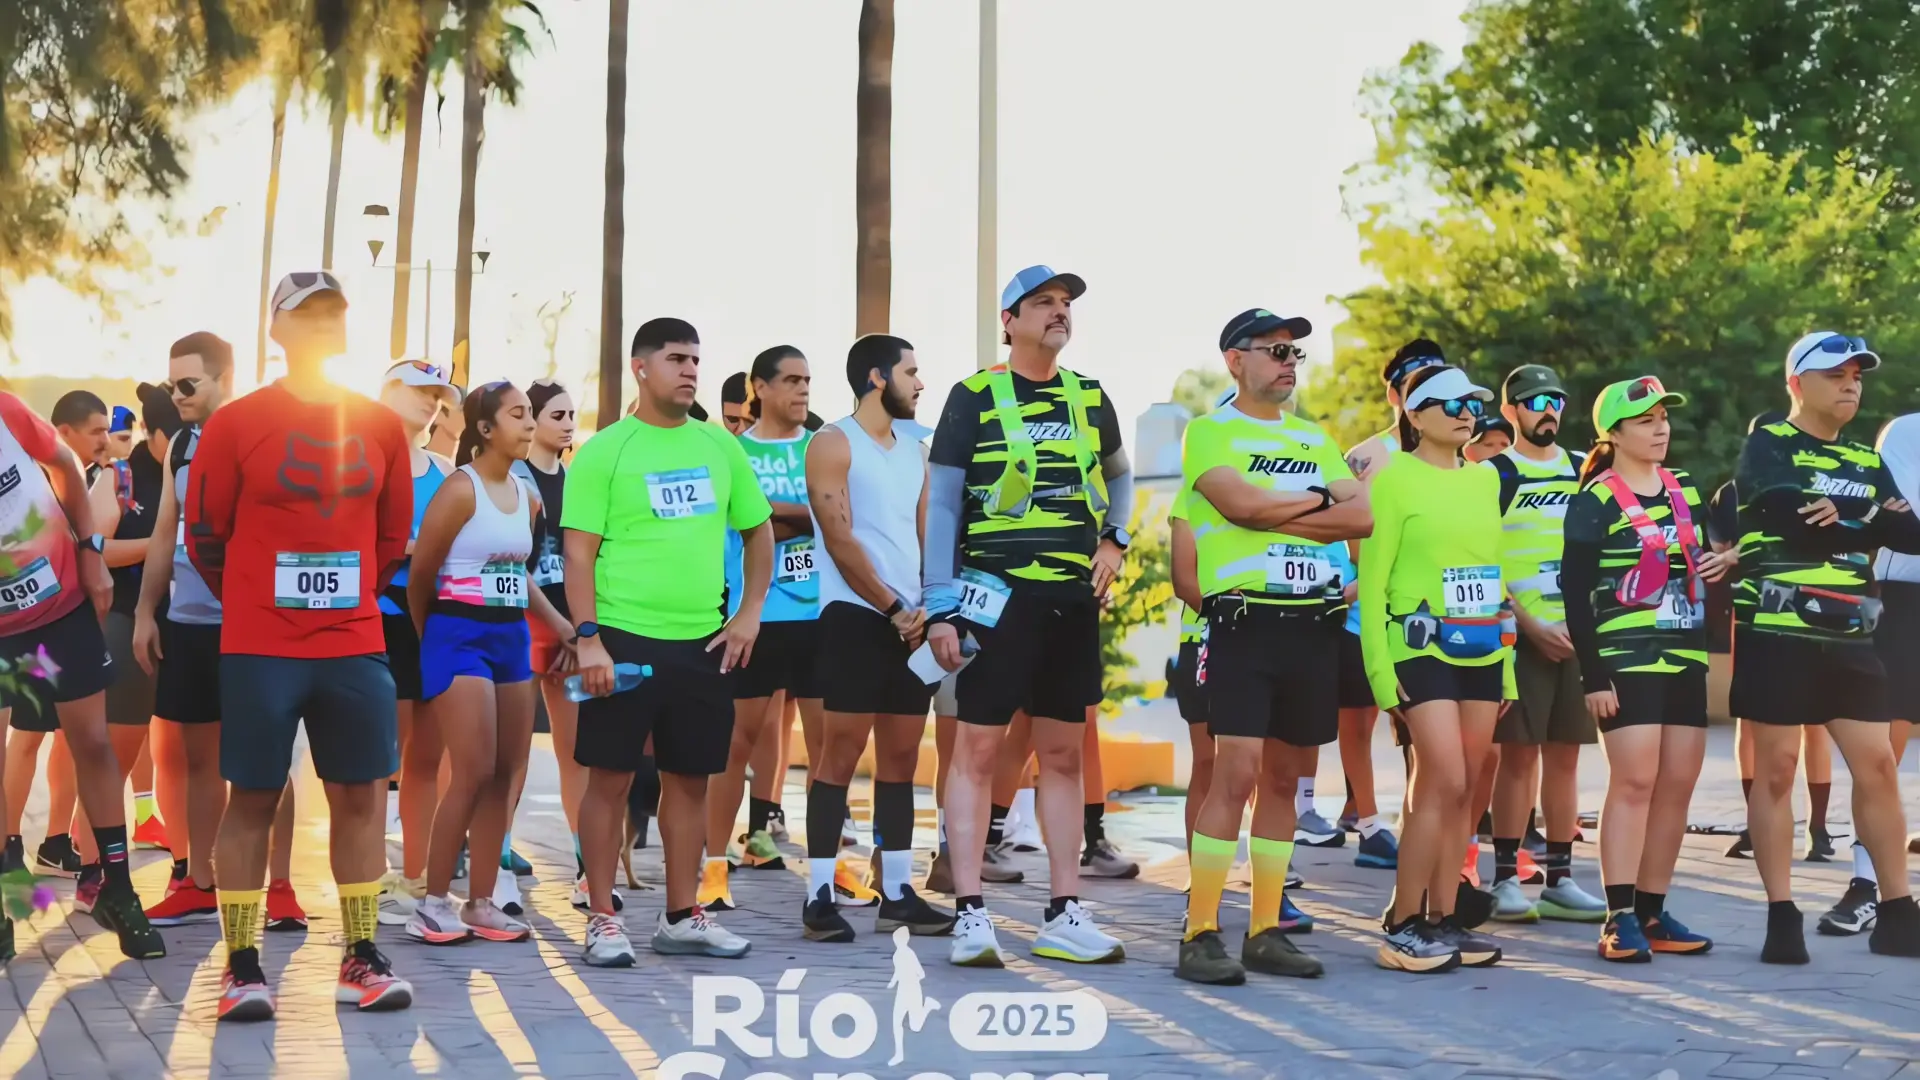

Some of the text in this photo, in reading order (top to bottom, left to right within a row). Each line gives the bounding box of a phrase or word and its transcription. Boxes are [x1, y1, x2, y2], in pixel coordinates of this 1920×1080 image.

[661, 484, 698, 505] 012
[1285, 561, 1316, 581] 010
[0, 577, 40, 602] 030
[297, 572, 339, 594] 005
[1456, 583, 1484, 602] 018
